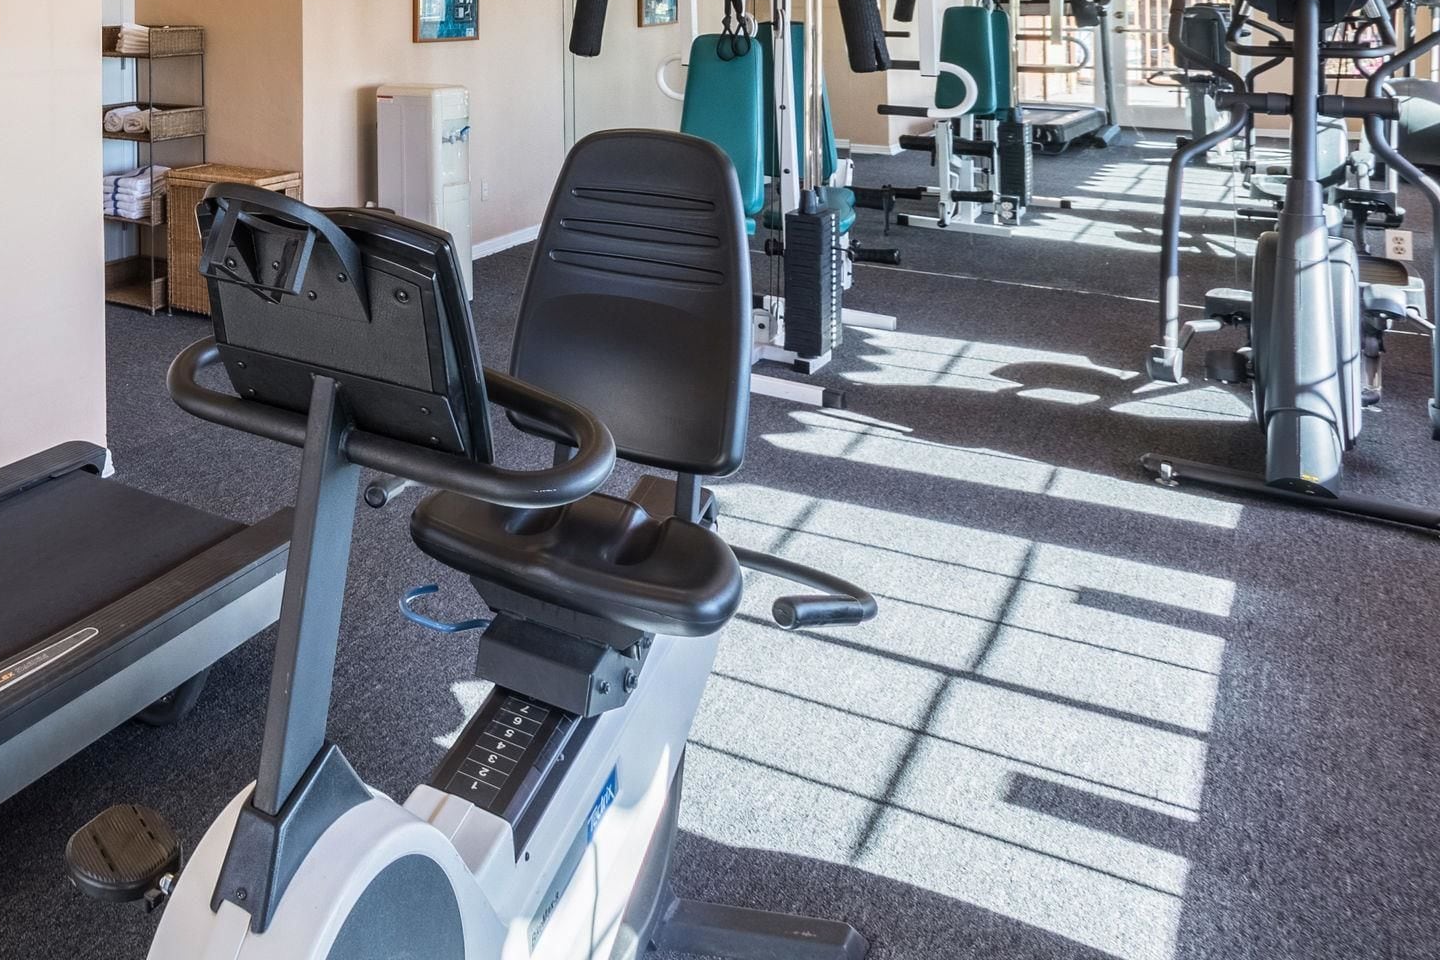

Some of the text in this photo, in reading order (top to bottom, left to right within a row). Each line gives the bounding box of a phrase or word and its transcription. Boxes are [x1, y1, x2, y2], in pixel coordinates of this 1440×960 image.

[520, 705, 530, 714] 7
[512, 716, 522, 725] 6
[504, 729, 515, 738] 5
[496, 741, 506, 750] 4
[487, 754, 498, 763] 3
[478, 766, 490, 777] 2
[471, 781, 478, 790] 1
